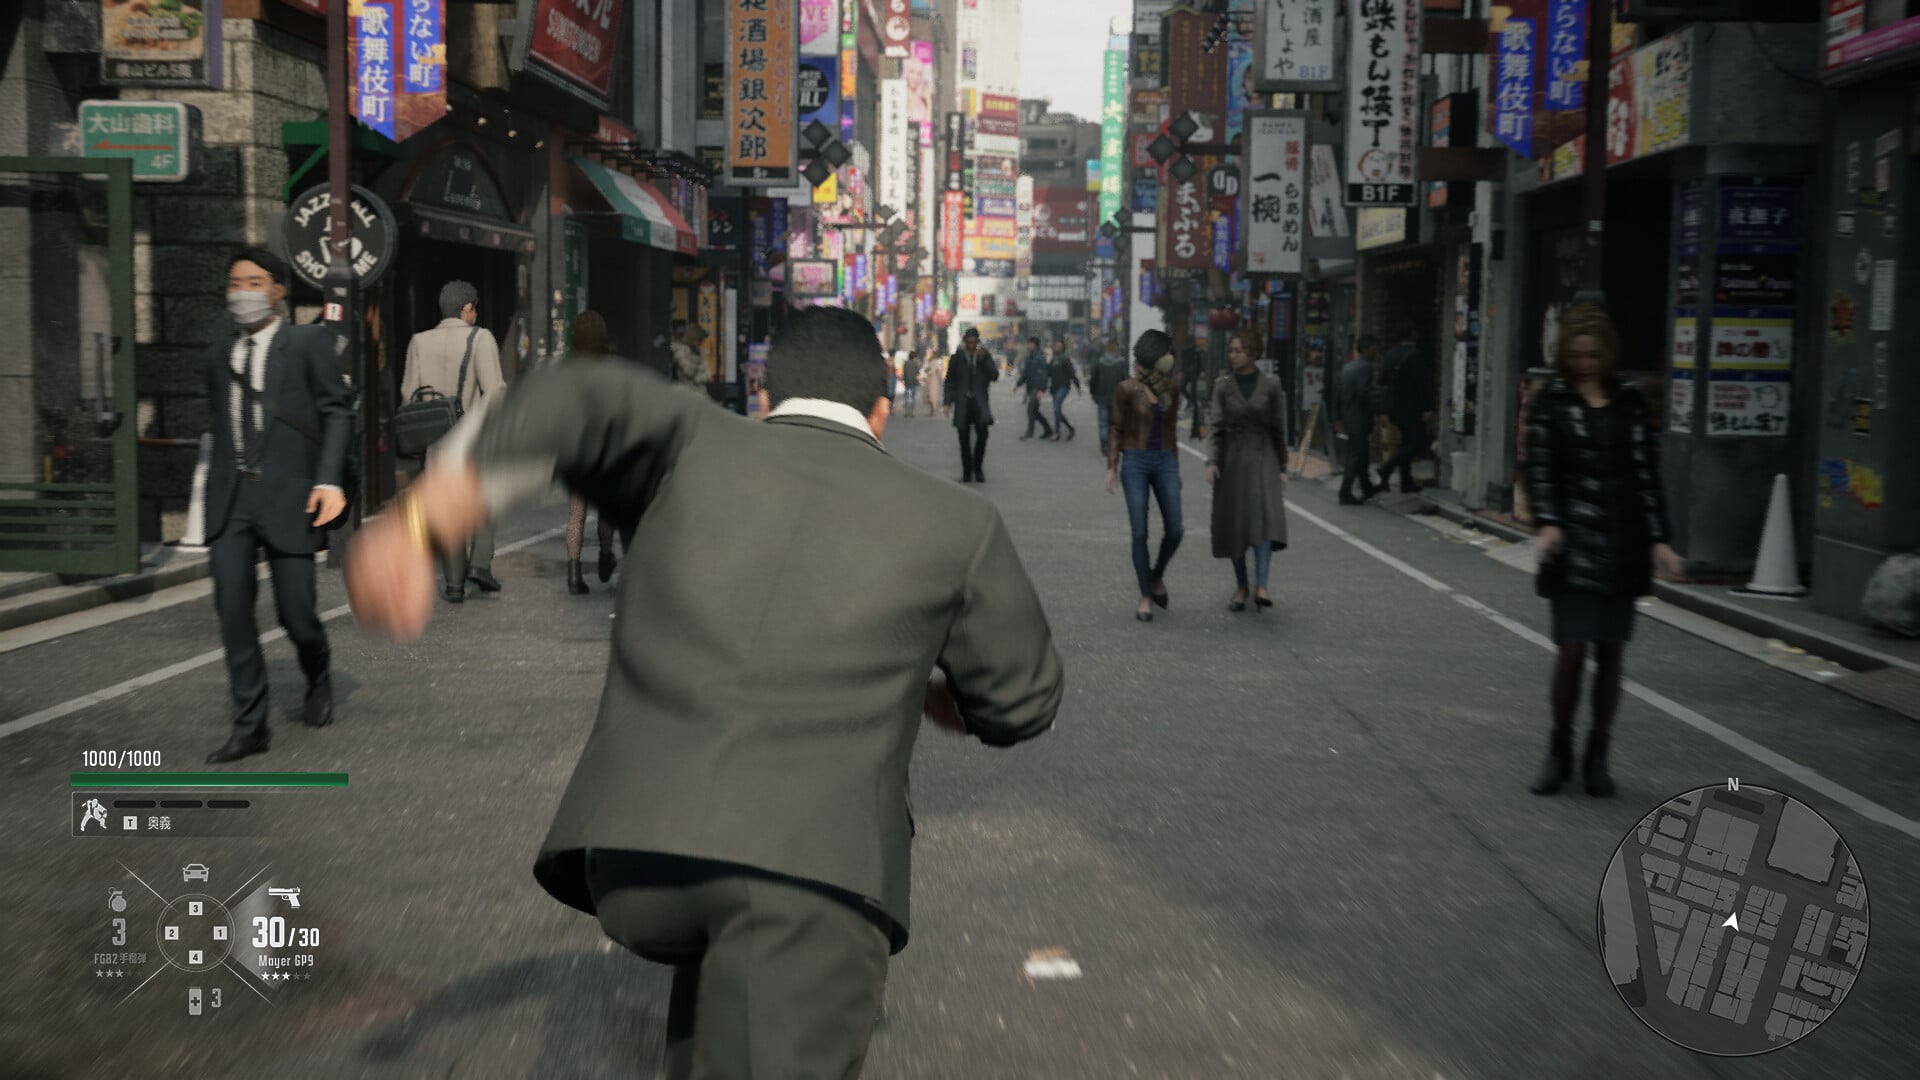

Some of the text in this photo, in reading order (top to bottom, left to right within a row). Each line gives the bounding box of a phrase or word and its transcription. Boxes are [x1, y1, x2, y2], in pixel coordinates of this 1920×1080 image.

[799, 7, 828, 21] VE
[1303, 0, 1322, 47] 酒屋
[361, 6, 389, 122] 歌舞伎町
[1549, 0, 1577, 105] らない町
[1299, 65, 1328, 80] B1F
[1498, 21, 1531, 141] 歌舞伎町
[87, 112, 176, 135] 大山歯科
[151, 154, 175, 169] 4F
[1362, 185, 1399, 200] B1F
[294, 193, 331, 228] JAZZ
